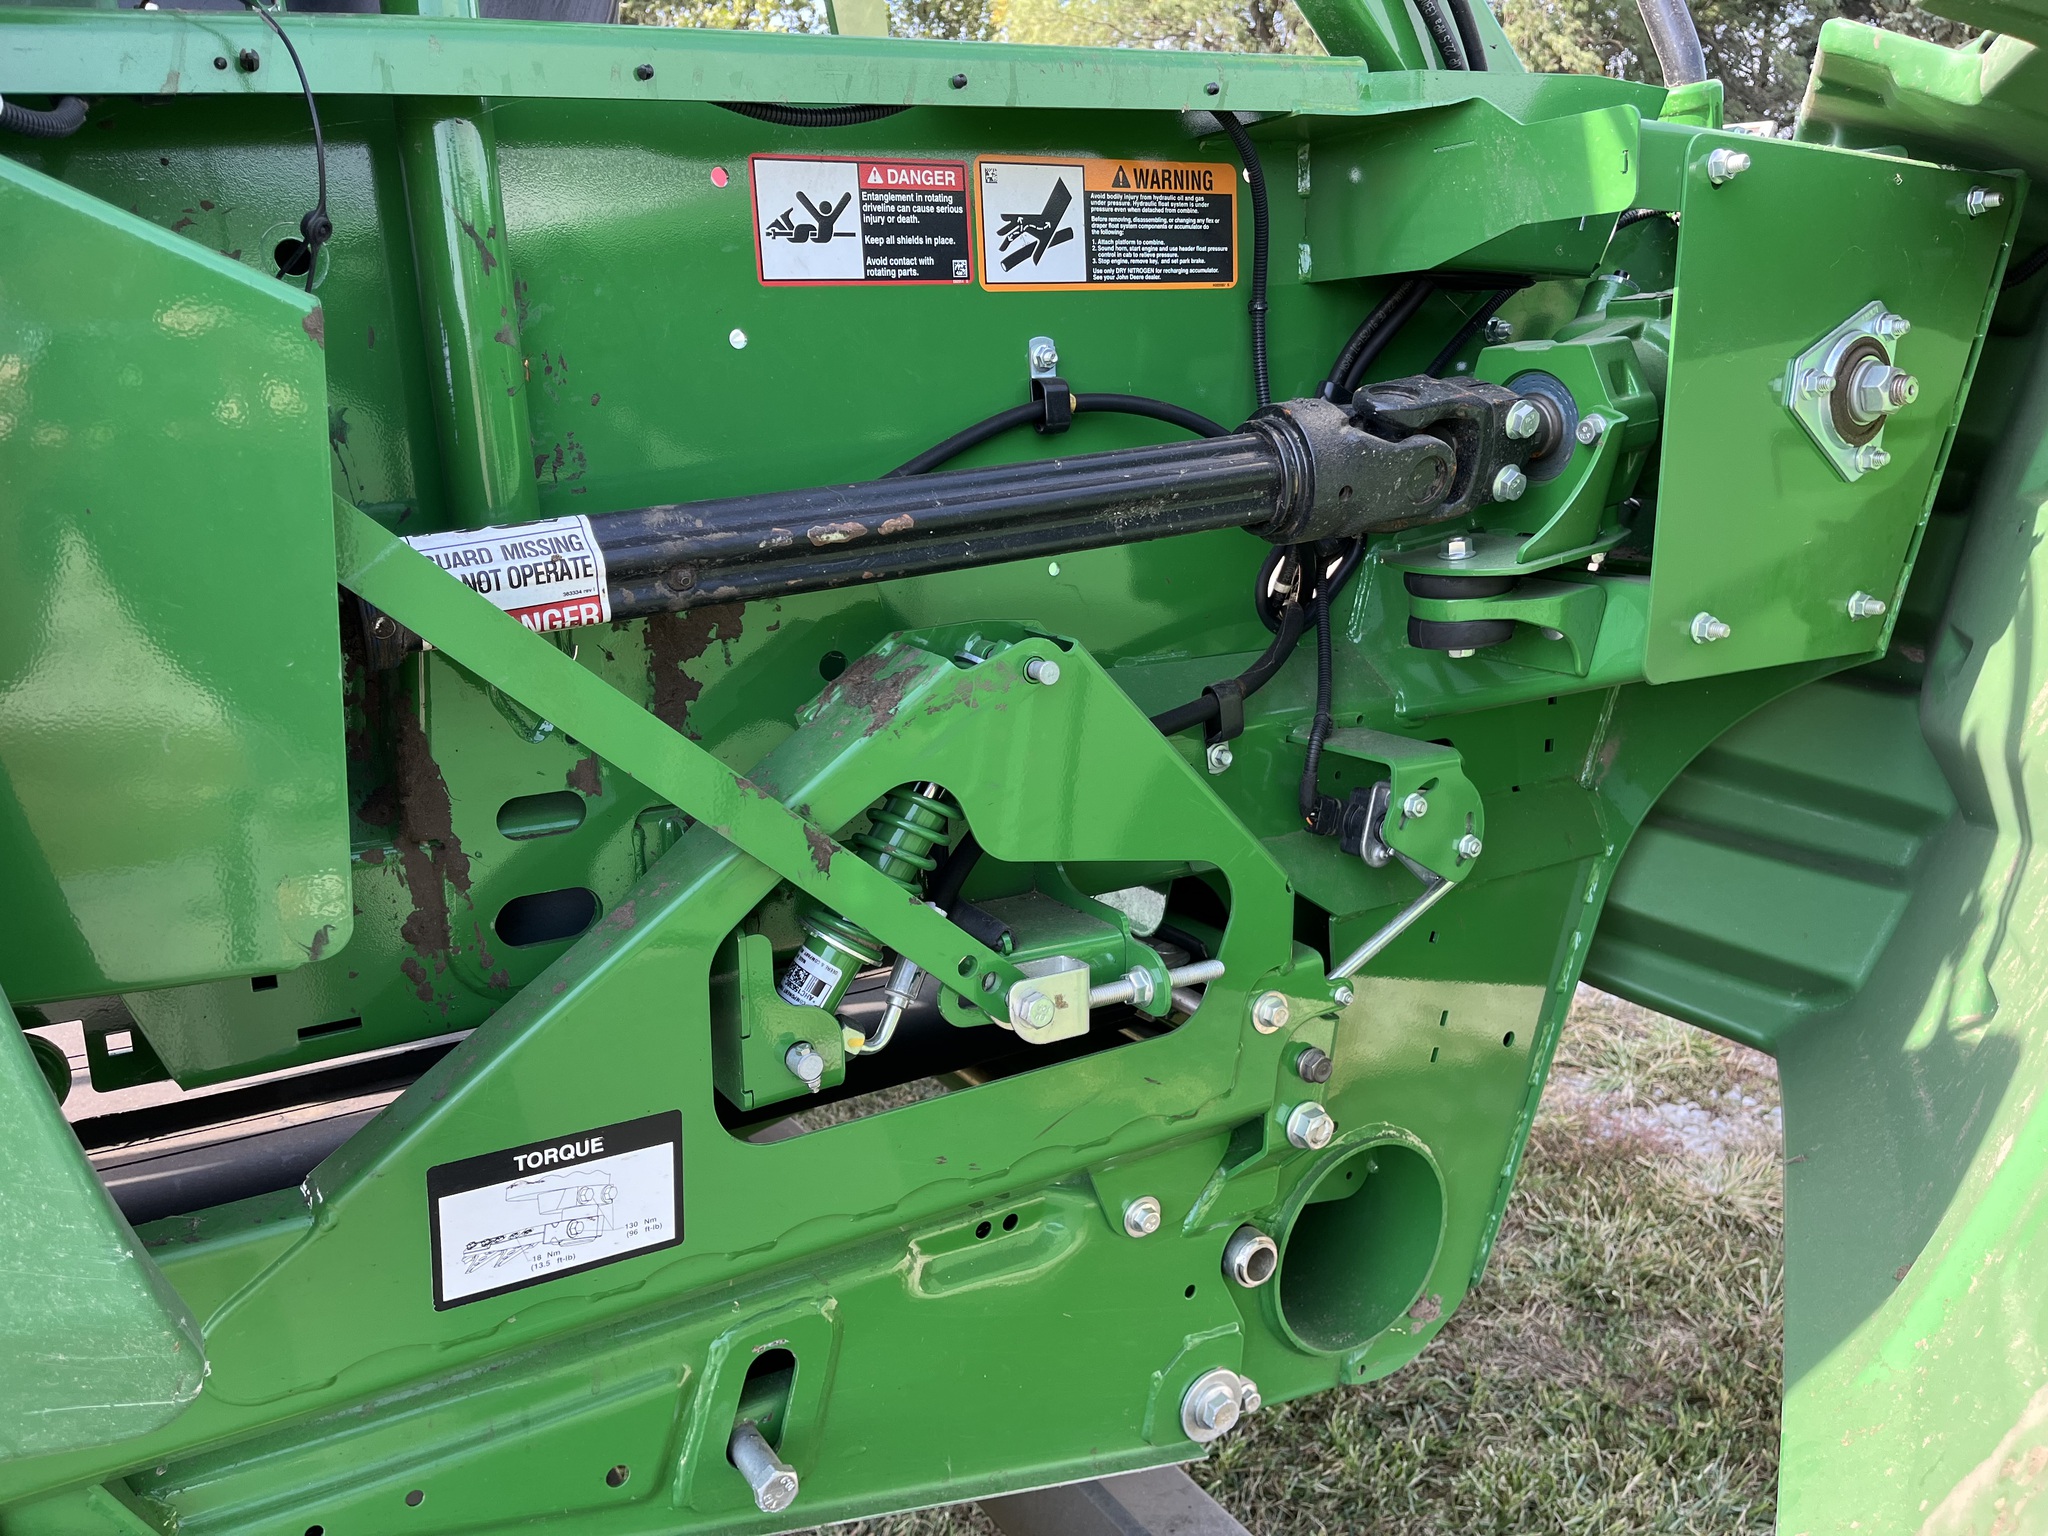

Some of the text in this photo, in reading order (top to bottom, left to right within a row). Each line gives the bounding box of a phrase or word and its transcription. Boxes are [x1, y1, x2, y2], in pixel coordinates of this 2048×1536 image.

[887, 168, 956, 186] DANGER
[1133, 167, 1213, 191] WARNING
[861, 191, 953, 204] Entanglement in rotating
[1106, 193, 1123, 201] bodily
[862, 203, 963, 214] driveline can cause serious
[863, 214, 920, 225] injury or death.
[864, 235, 956, 247] Keep all shields in place.
[866, 256, 935, 266] Avoid contact with
[867, 267, 919, 278] rotating parts.
[500, 533, 584, 561] MISSING
[461, 554, 594, 594] NOT OPERATE
[520, 602, 601, 631] NGER
[513, 1137, 605, 1171] TORQUE
[625, 1216, 657, 1230] 130 Nm
[626, 1223, 663, 1238] (96 ft-lb)
[530, 1253, 576, 1272] (13.5 ft-lb)
[532, 1250, 561, 1262] 18 Nm
